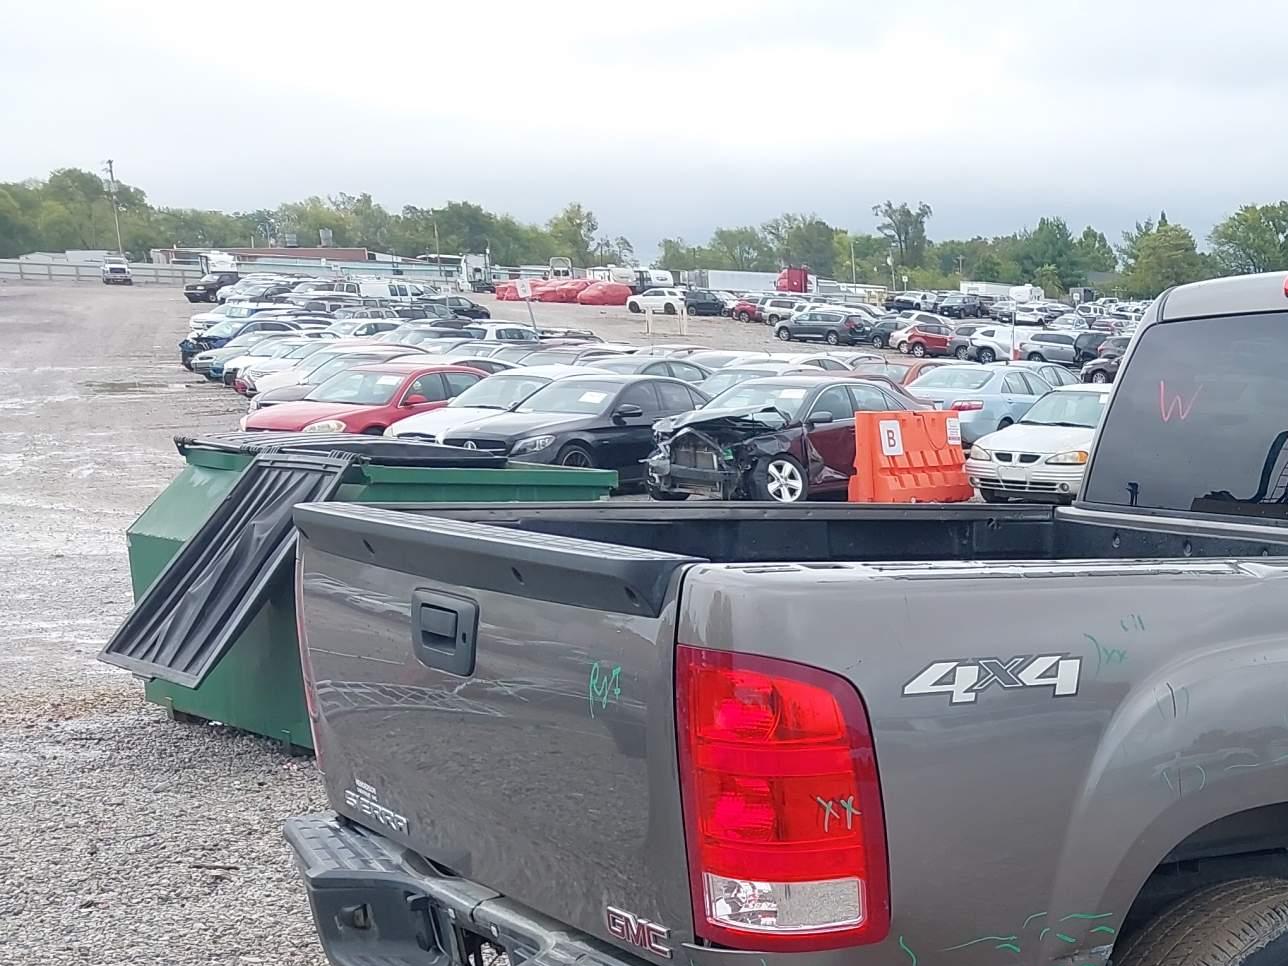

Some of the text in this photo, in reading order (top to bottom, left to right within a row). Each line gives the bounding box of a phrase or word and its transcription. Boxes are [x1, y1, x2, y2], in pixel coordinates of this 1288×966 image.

[886, 429, 897, 448] B
[344, 789, 410, 836] SIERRA
[607, 905, 673, 960] GMC
